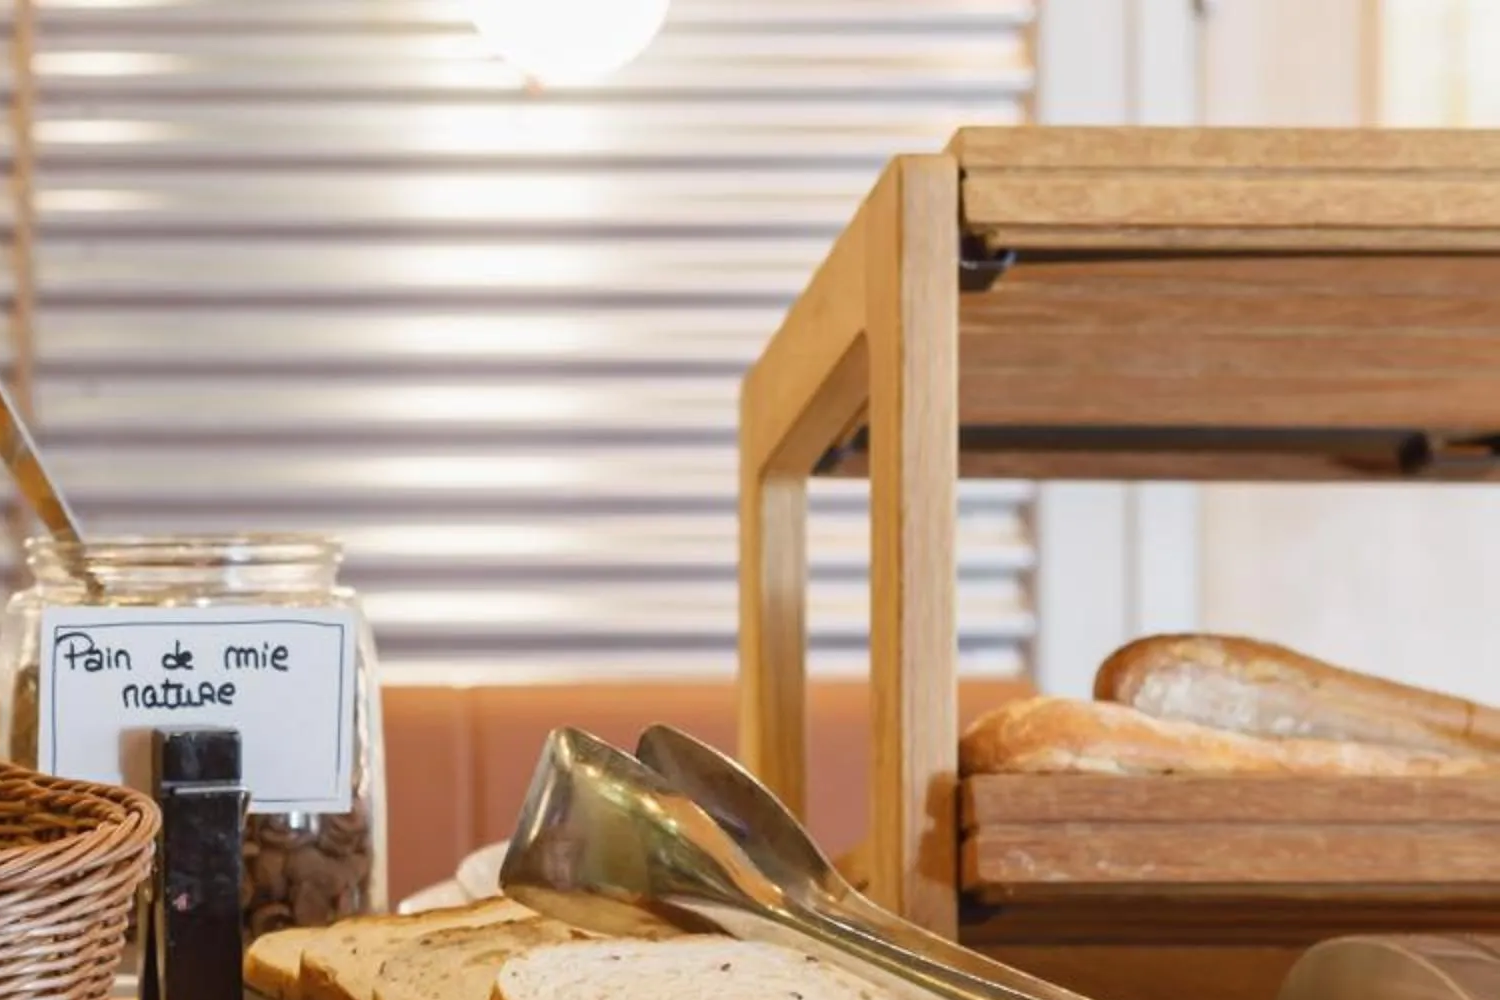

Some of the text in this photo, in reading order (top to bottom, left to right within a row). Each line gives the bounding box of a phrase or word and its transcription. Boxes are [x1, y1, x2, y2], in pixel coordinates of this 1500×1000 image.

[55, 631, 289, 673] Pain de mie
